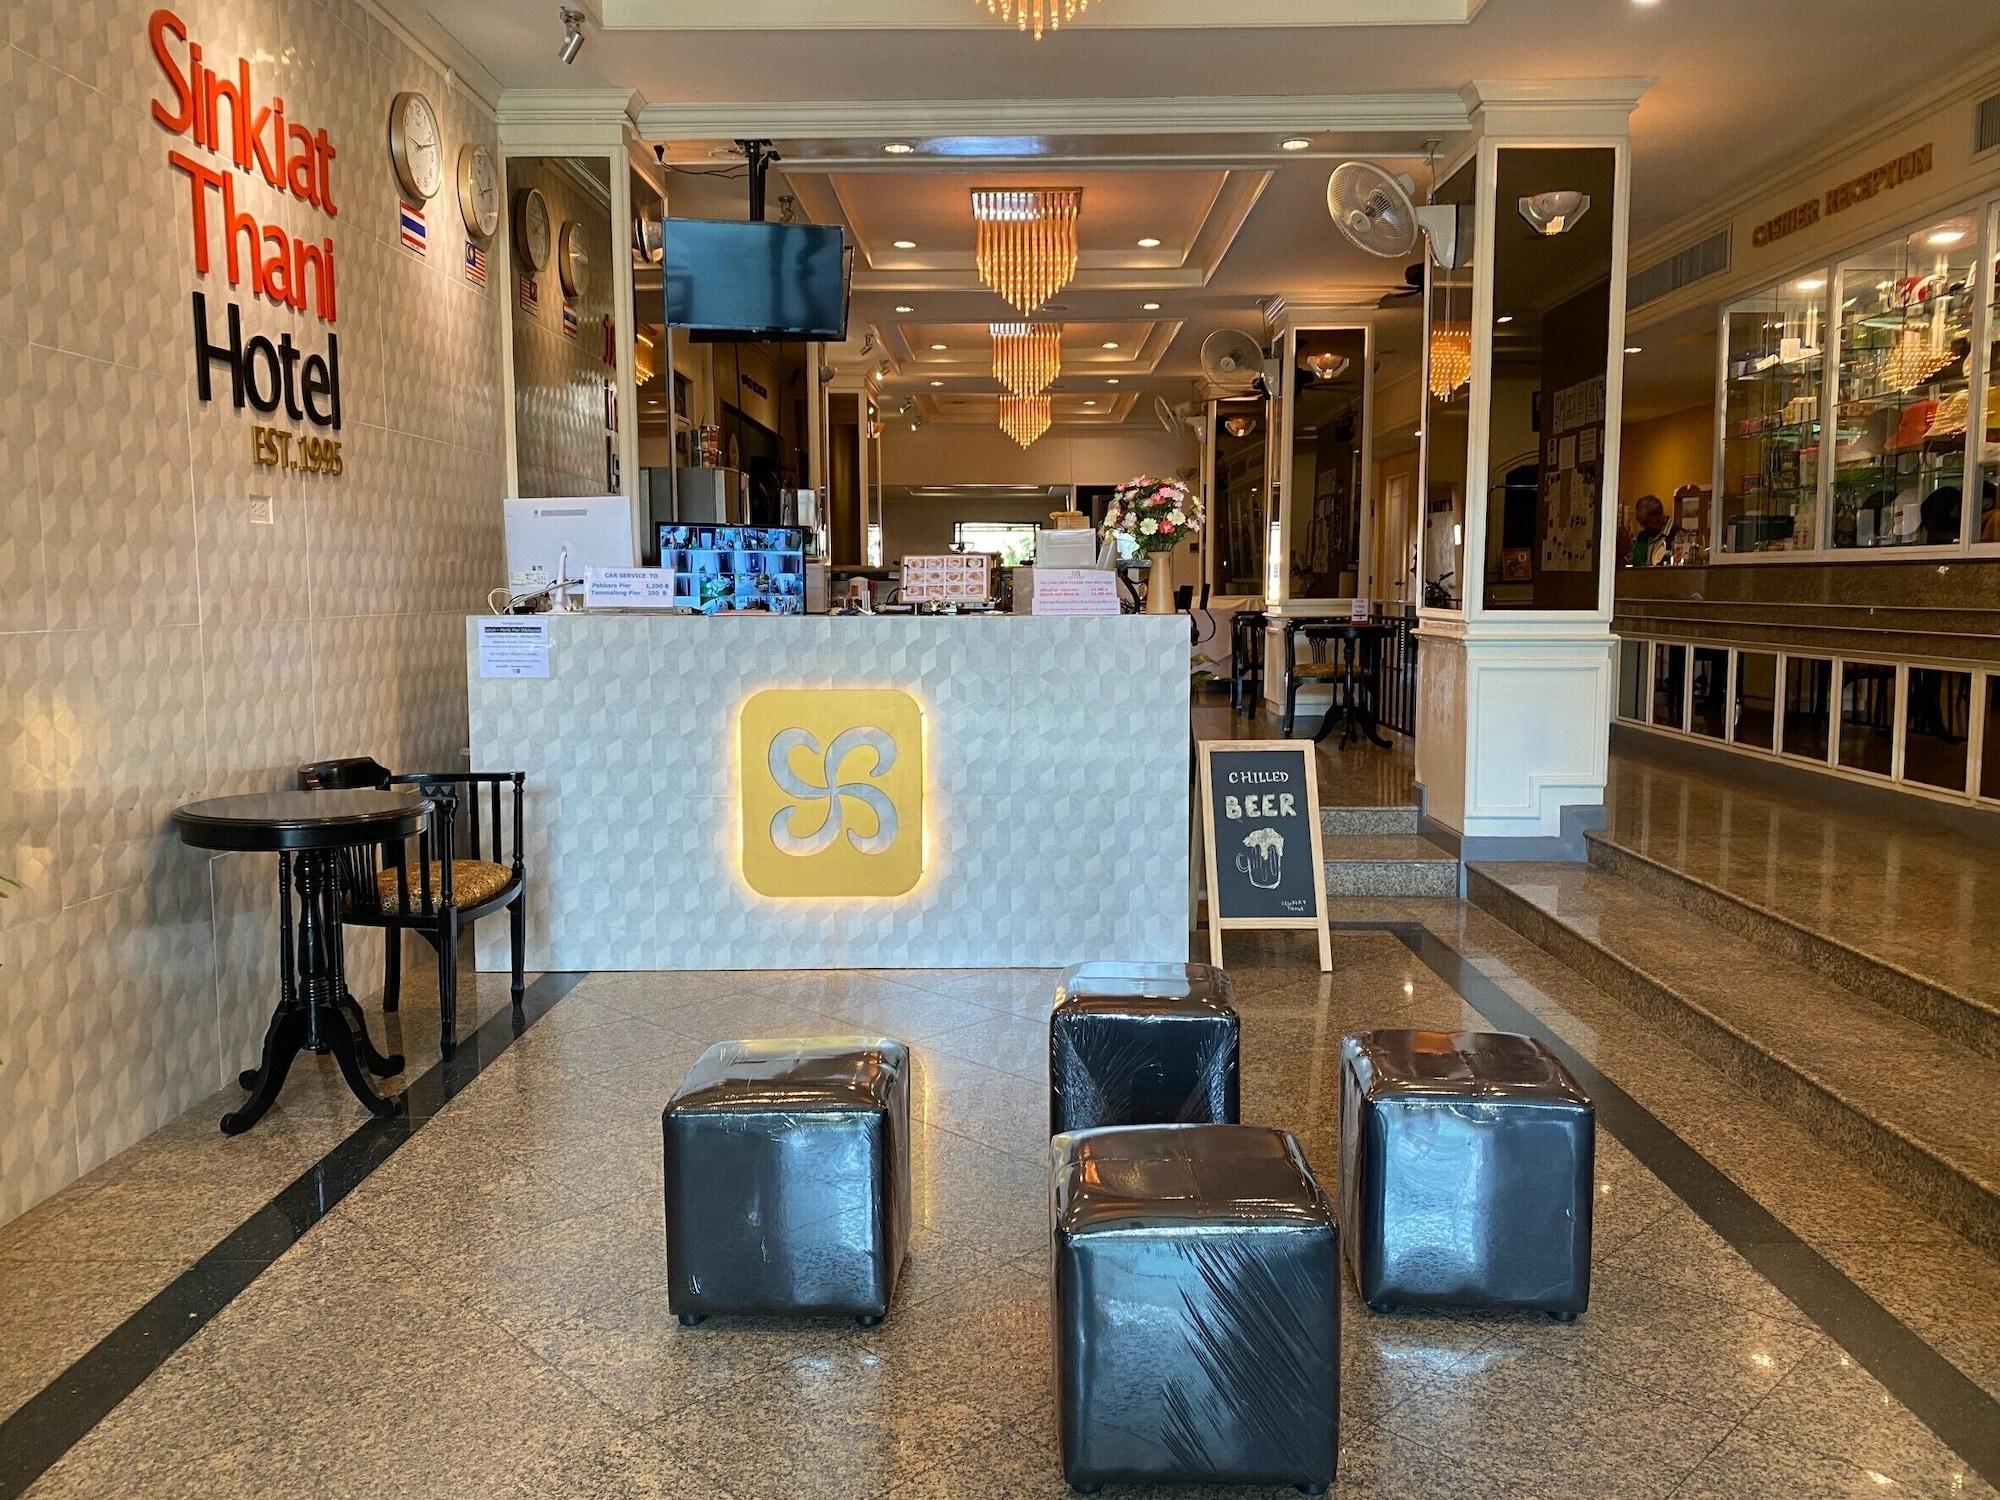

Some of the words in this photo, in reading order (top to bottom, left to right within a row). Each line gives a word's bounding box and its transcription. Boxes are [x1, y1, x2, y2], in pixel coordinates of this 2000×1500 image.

[148, 8, 338, 216] Sinkiat
[169, 150, 336, 322] Thani
[1752, 199, 1820, 248] CASHIER
[1825, 143, 1933, 216] RECEPTION
[192, 291, 341, 430] Hotel
[250, 425, 343, 476] EST.1995
[1225, 793, 1297, 820] BEER
[1228, 770, 1289, 784] CHILLED
